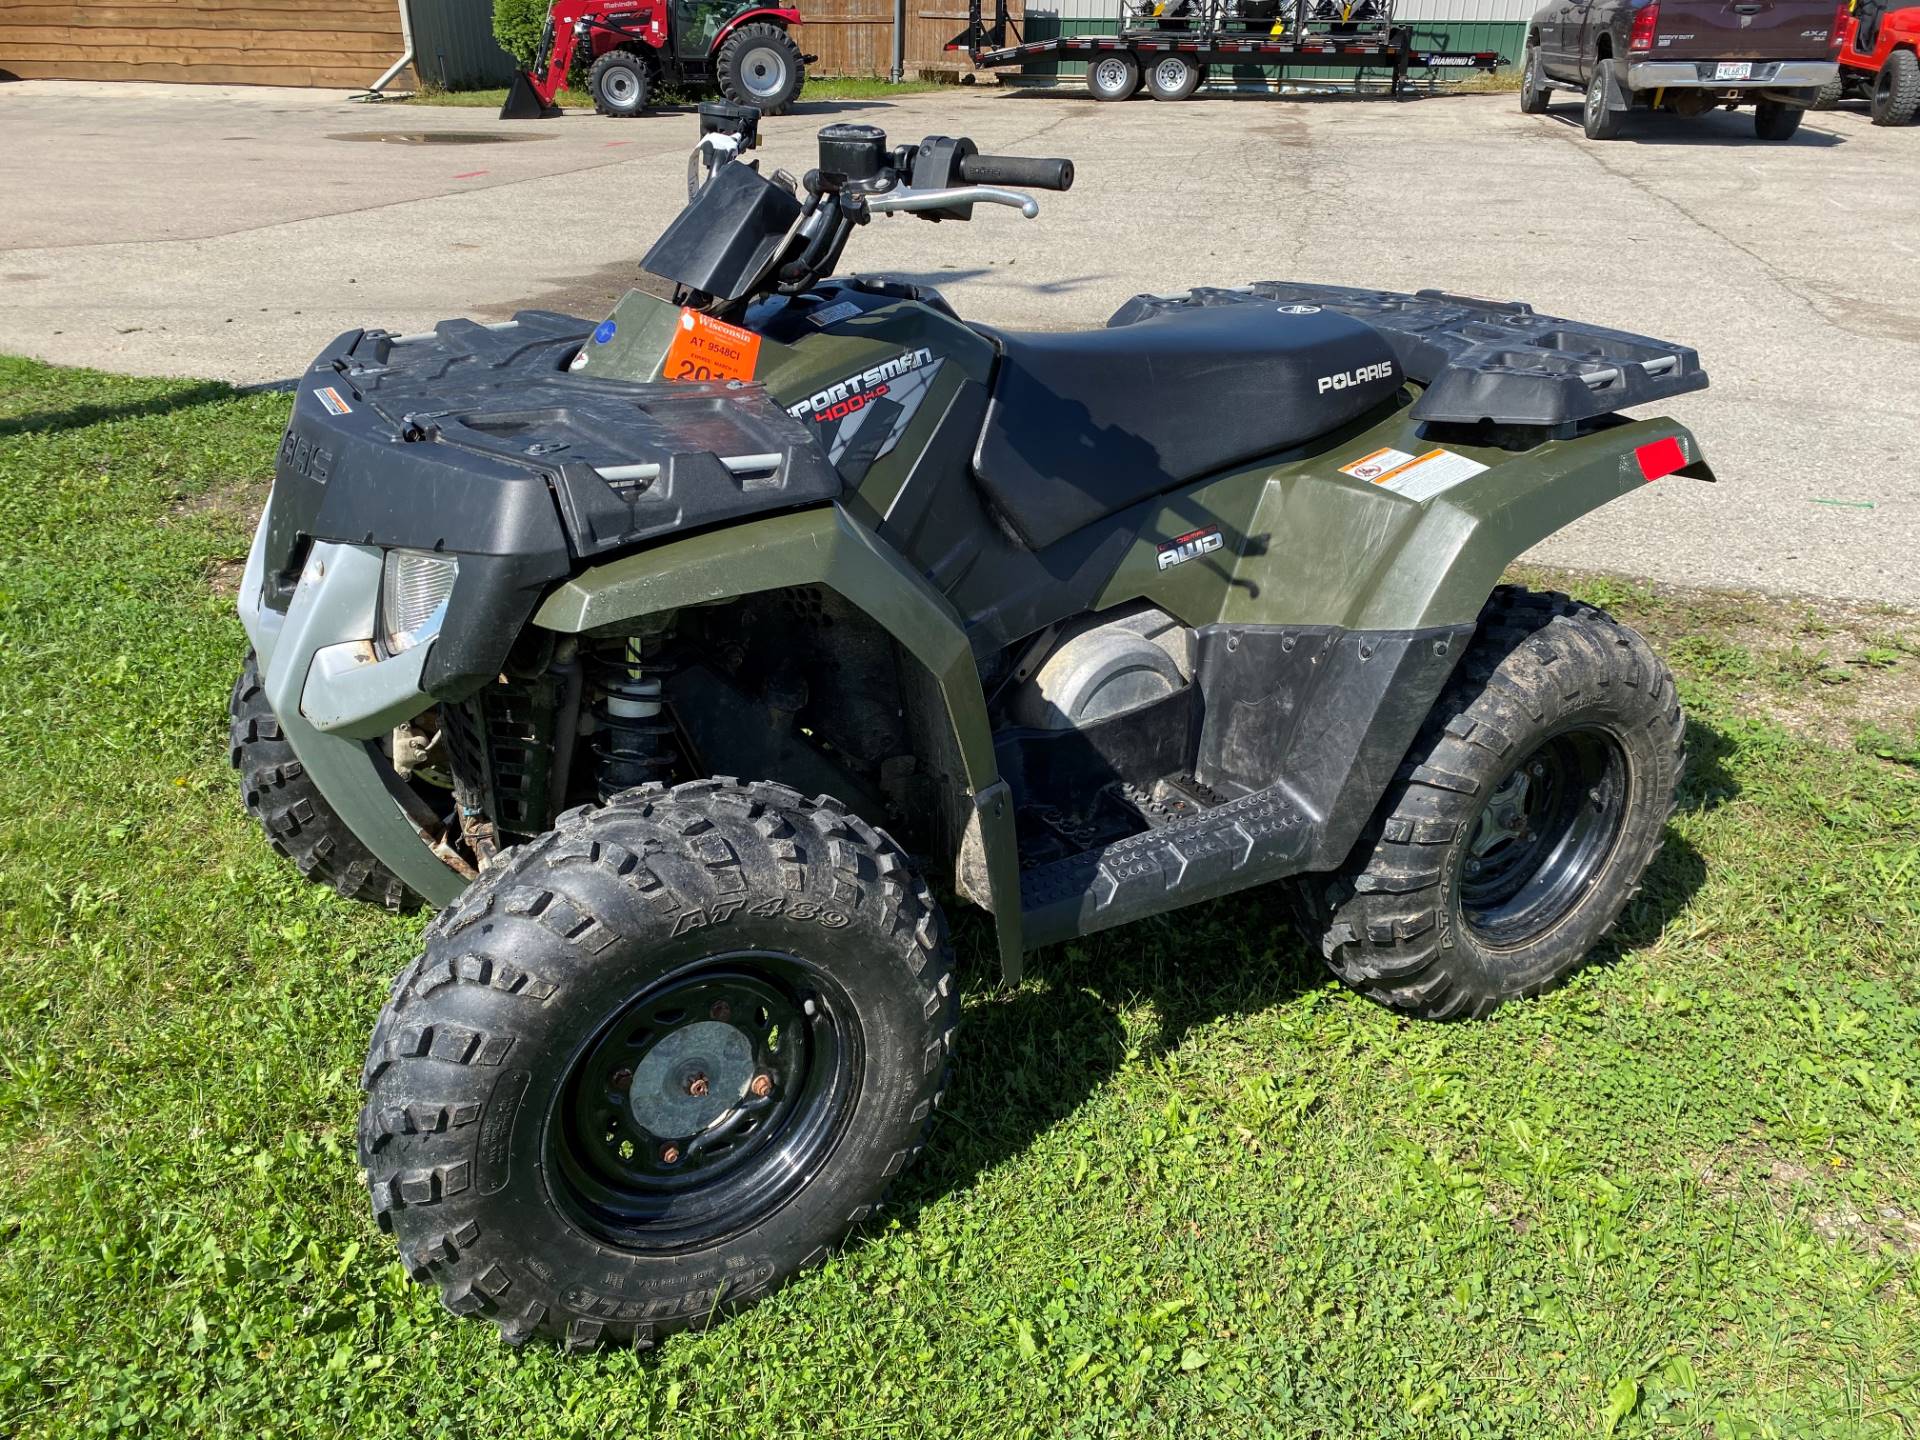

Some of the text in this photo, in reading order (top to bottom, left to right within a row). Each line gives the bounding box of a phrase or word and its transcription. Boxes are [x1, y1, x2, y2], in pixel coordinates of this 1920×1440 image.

[603, 1, 638, 9] Mahindra
[1429, 54, 1476, 66] DIAMOND C
[690, 336, 705, 348] AT
[699, 313, 751, 343] Wisconsin
[1317, 360, 1393, 395] POLARIS
[1157, 532, 1224, 570] AWD
[670, 896, 849, 938] AT 489
